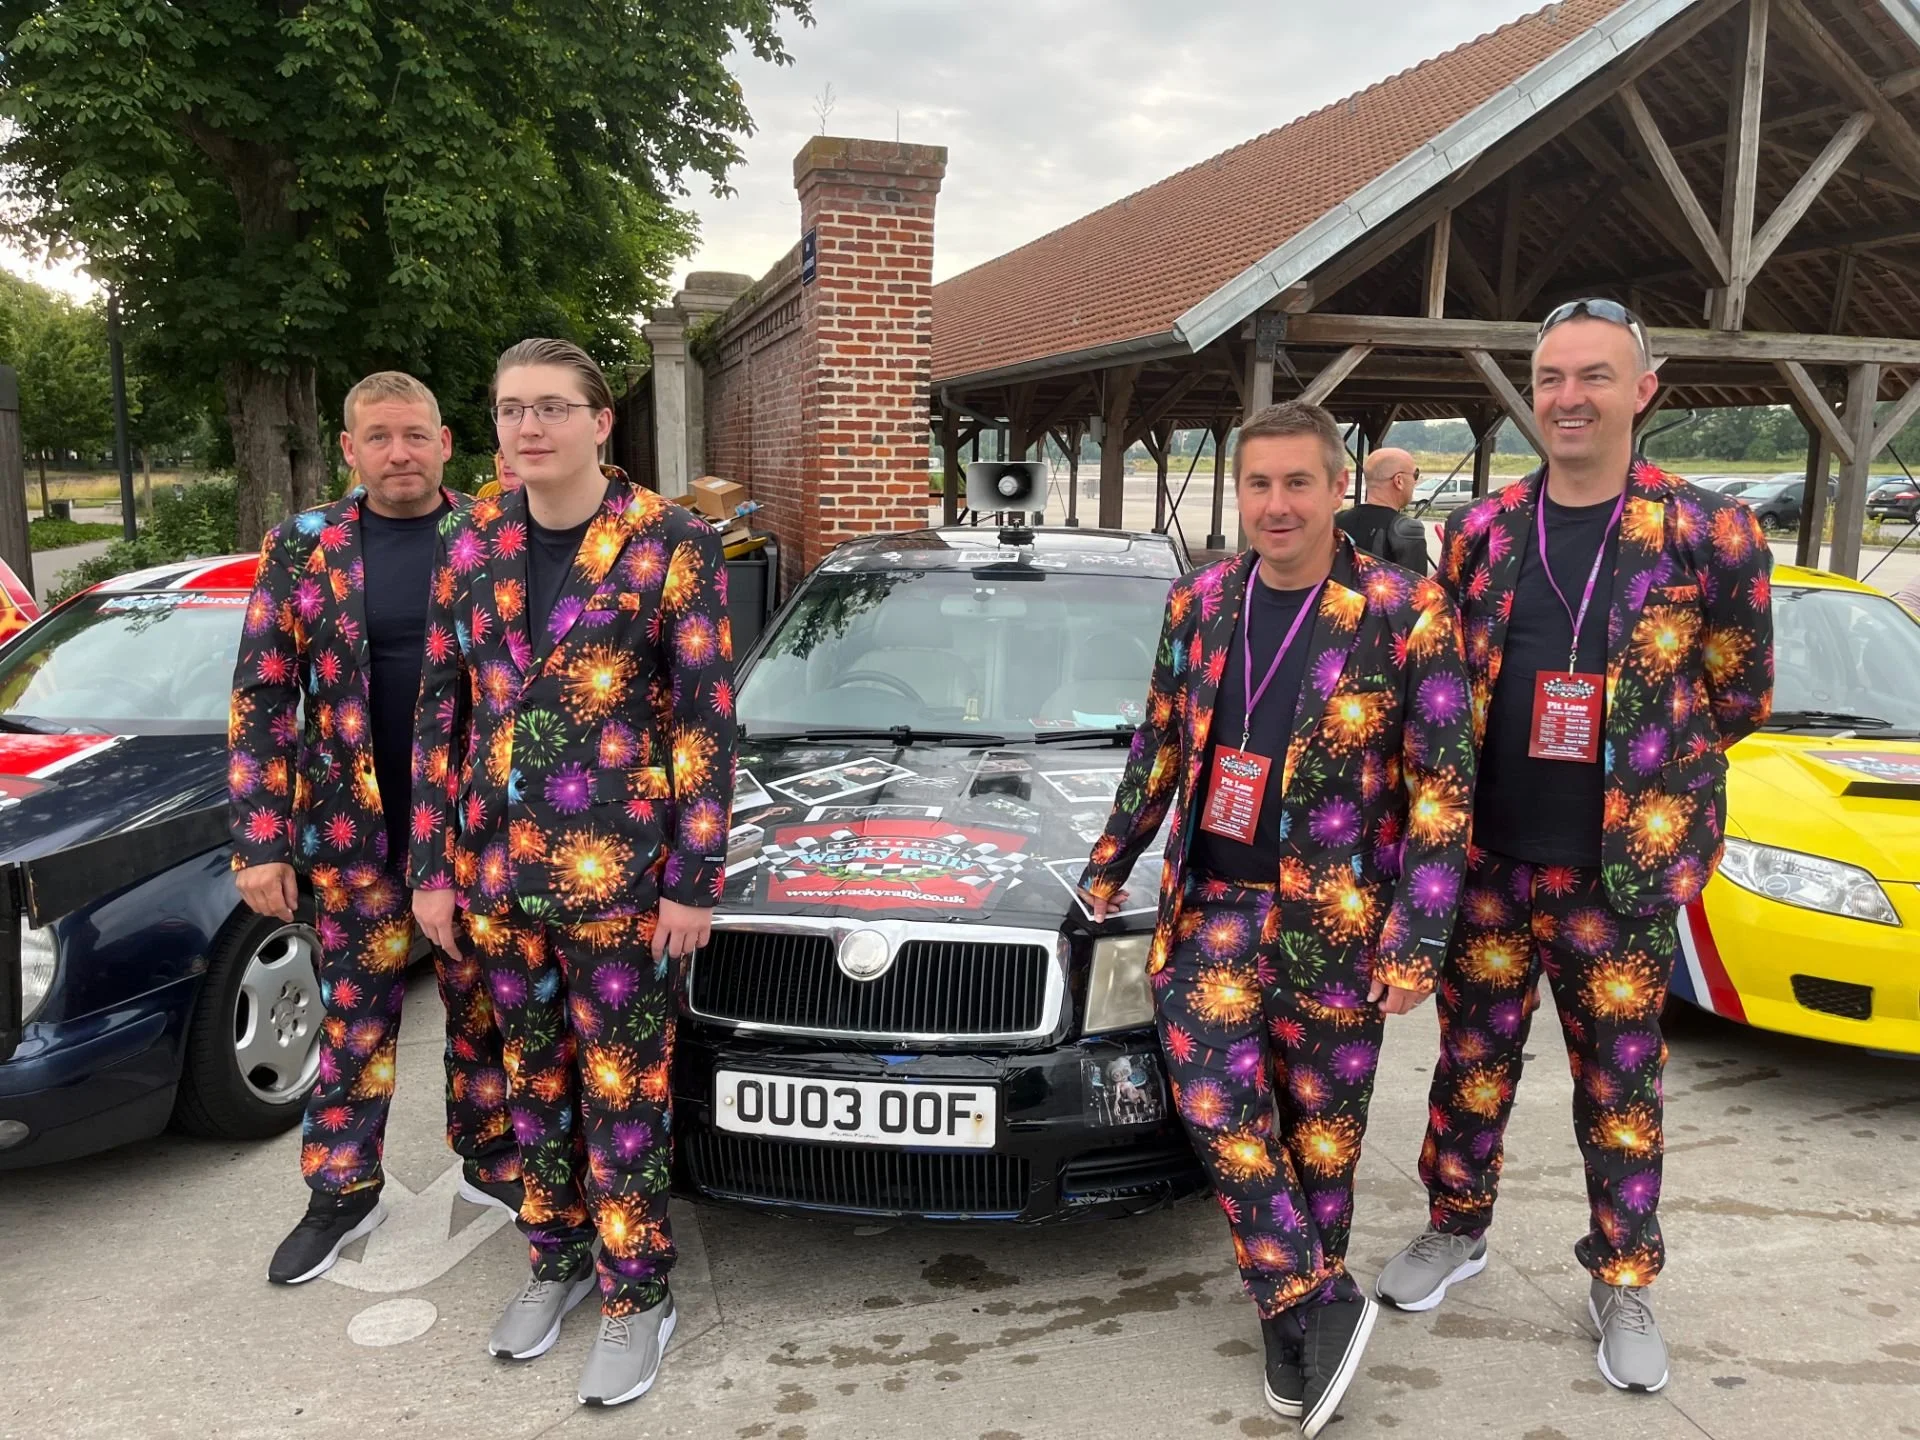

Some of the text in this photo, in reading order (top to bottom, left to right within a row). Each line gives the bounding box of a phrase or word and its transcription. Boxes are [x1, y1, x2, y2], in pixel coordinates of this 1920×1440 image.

[799, 847, 980, 871] Wacky Rally
[785, 889, 966, 904] www.wackyrally.co.uk
[736, 1079, 862, 1131] OU03
